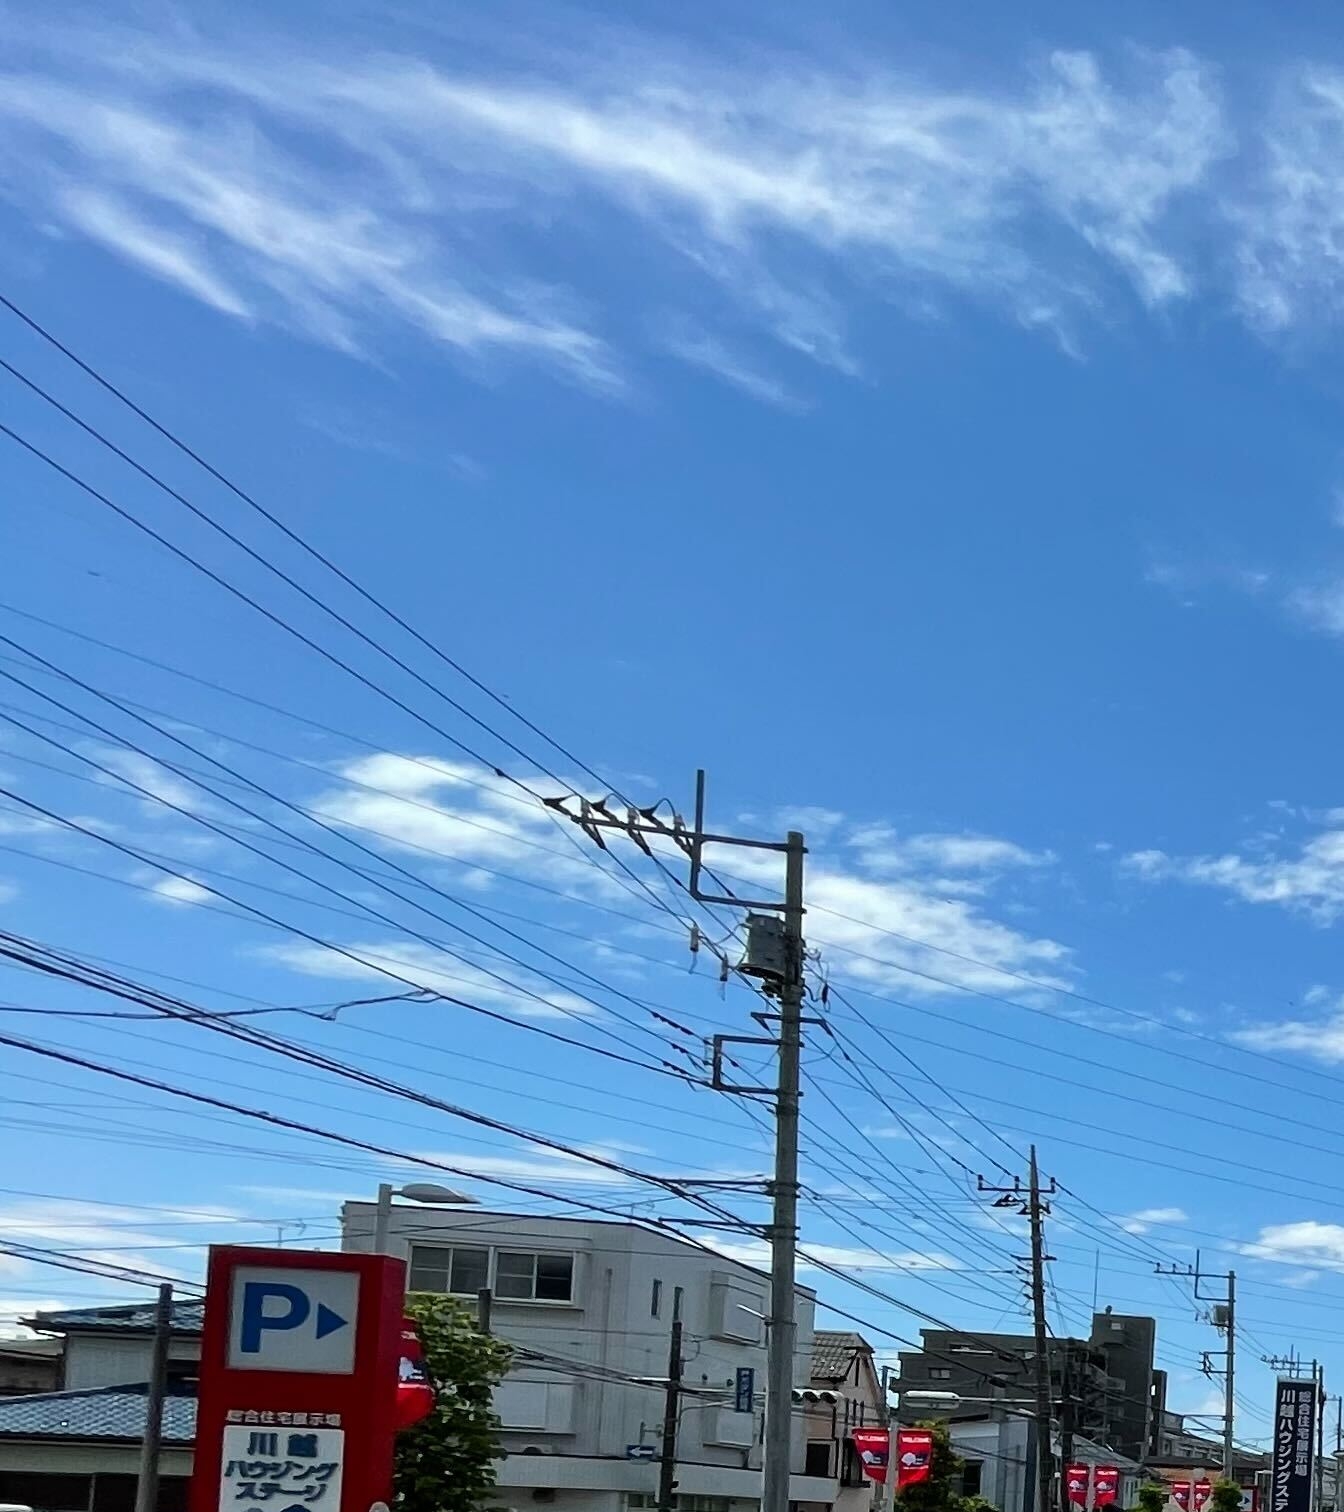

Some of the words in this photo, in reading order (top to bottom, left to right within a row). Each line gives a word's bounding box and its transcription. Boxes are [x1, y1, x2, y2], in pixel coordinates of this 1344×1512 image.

[240, 1281, 310, 1354] P
[224, 1460, 339, 1482] ハウジング
[235, 1481, 329, 1502] ステージ
